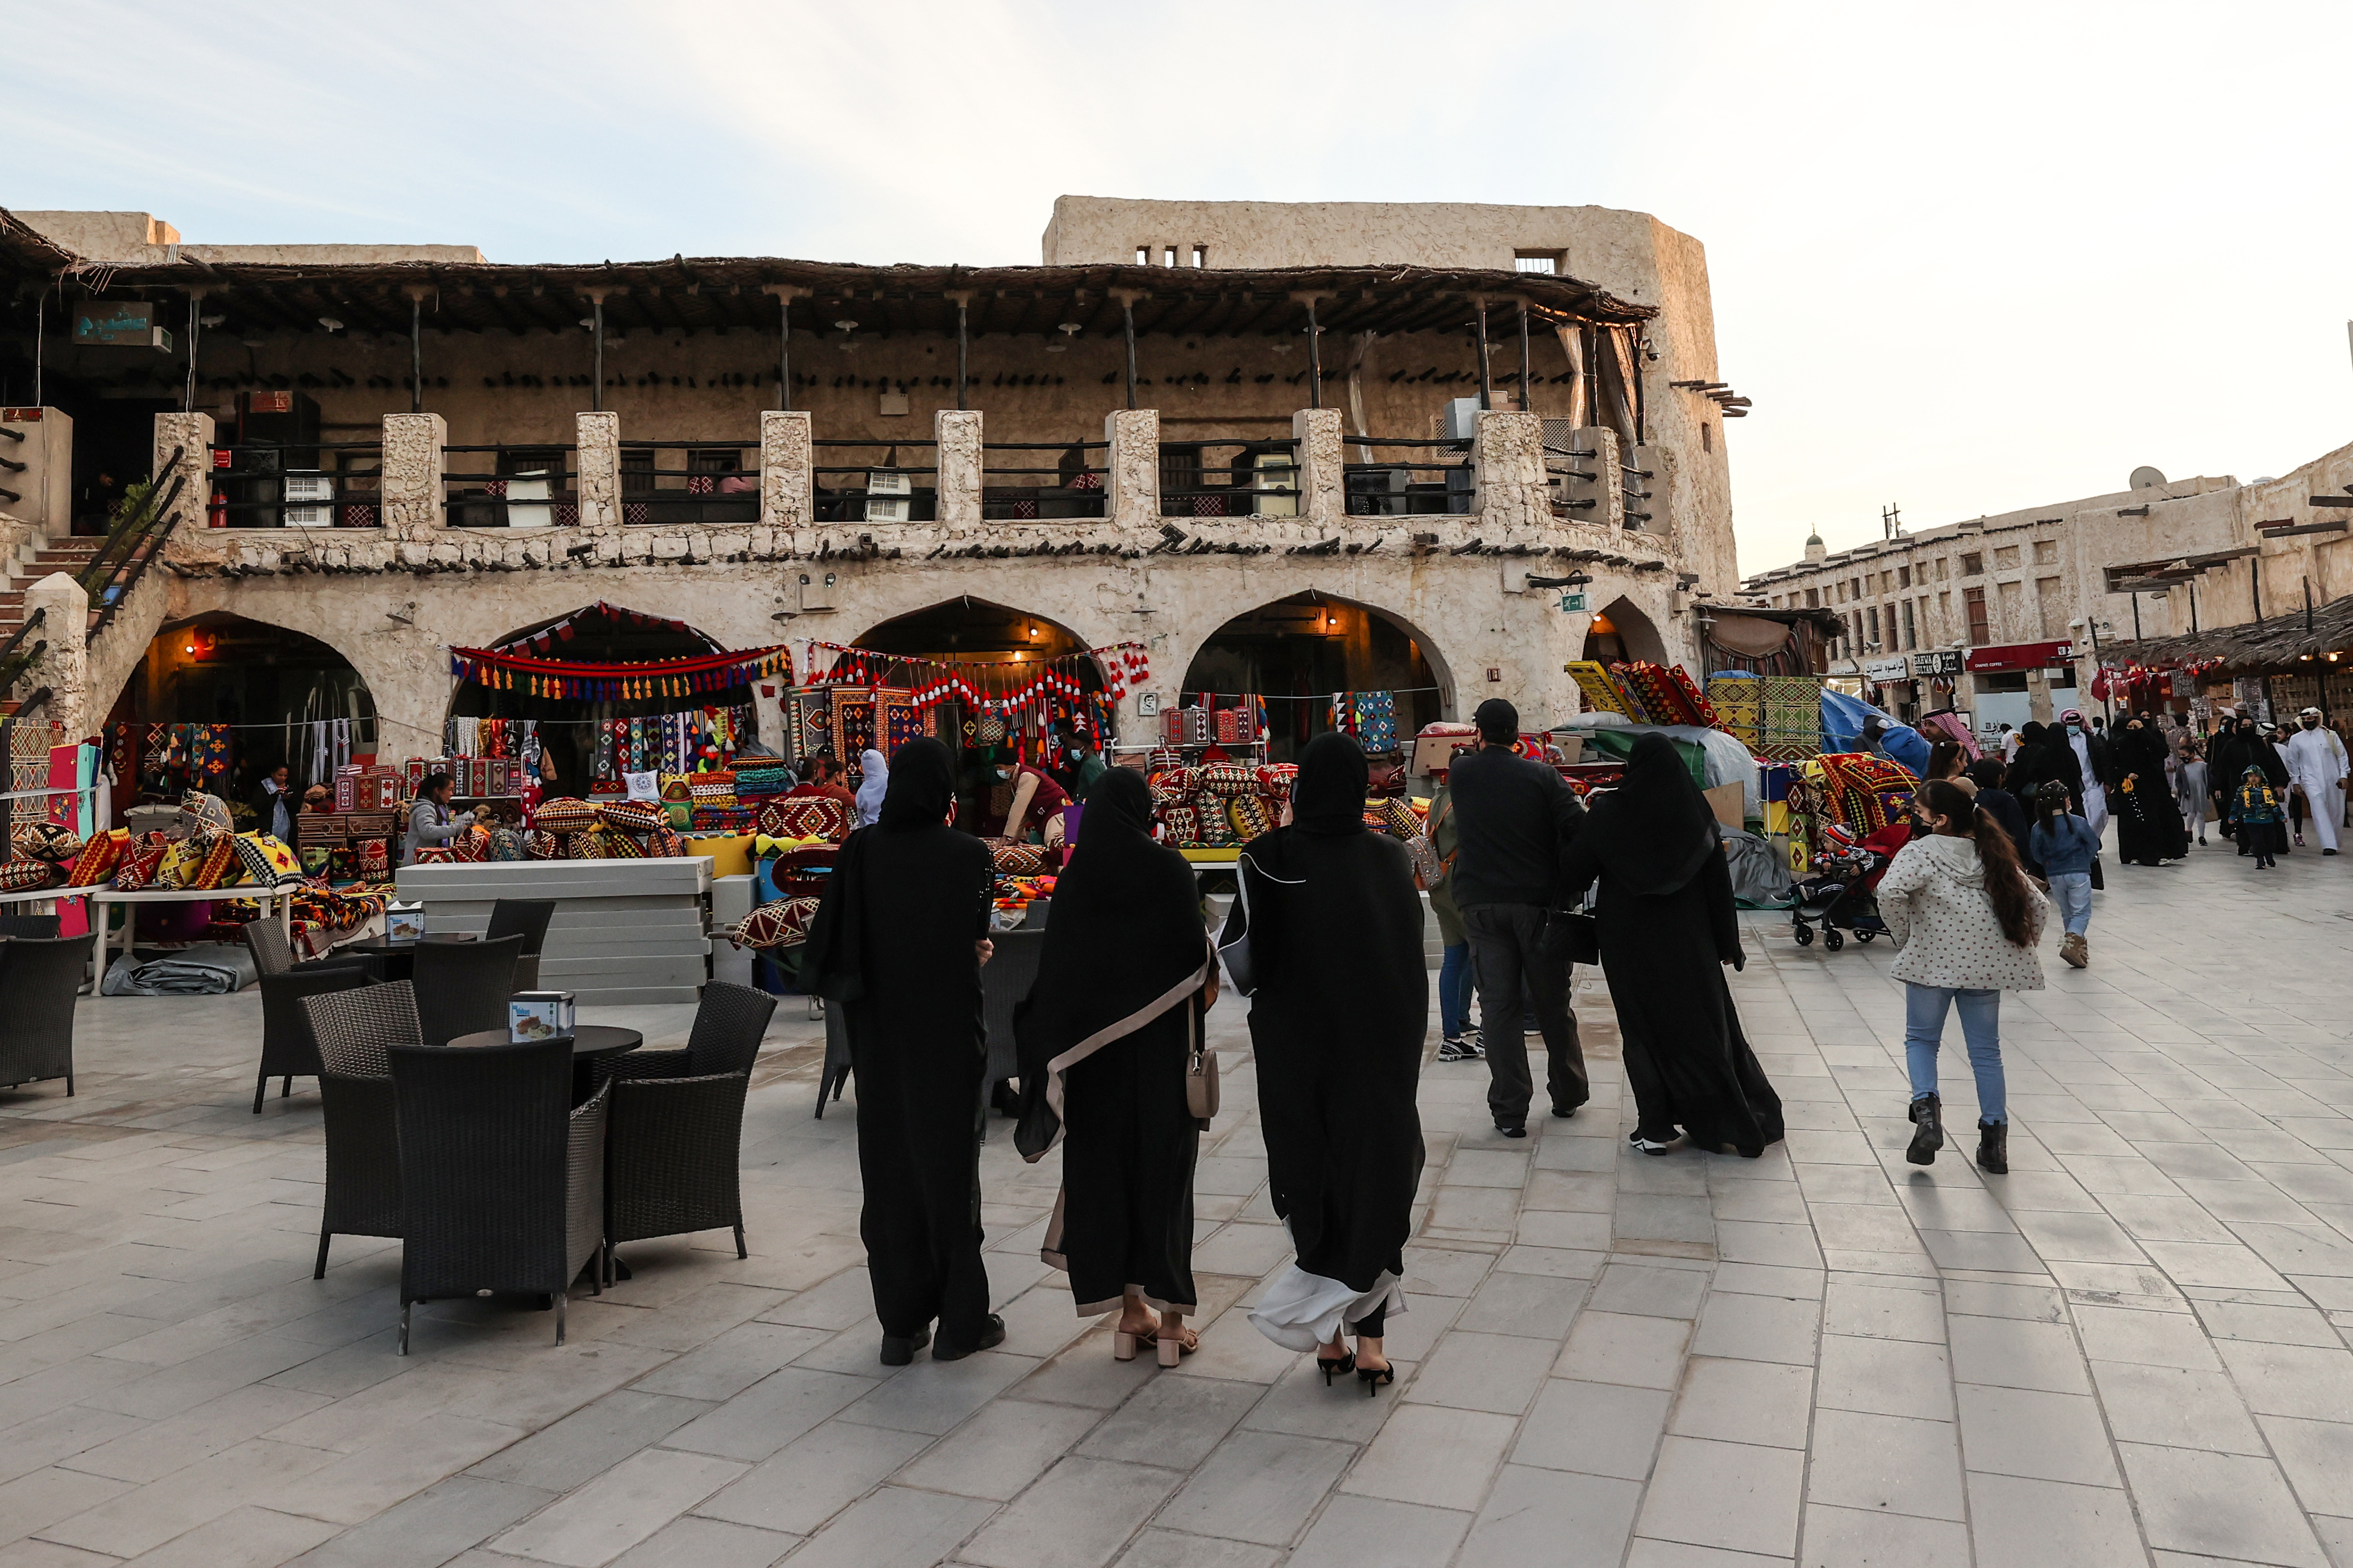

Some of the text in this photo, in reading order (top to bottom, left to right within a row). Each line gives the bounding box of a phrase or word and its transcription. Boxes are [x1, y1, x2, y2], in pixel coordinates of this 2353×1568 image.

[1942, 652, 1956, 663] قهوة
[1866, 663, 1882, 675] للتراث
[1915, 665, 1933, 675] SULTAN
[1942, 663, 1957, 673] سلطان
[1038, 807, 1045, 816] 67
